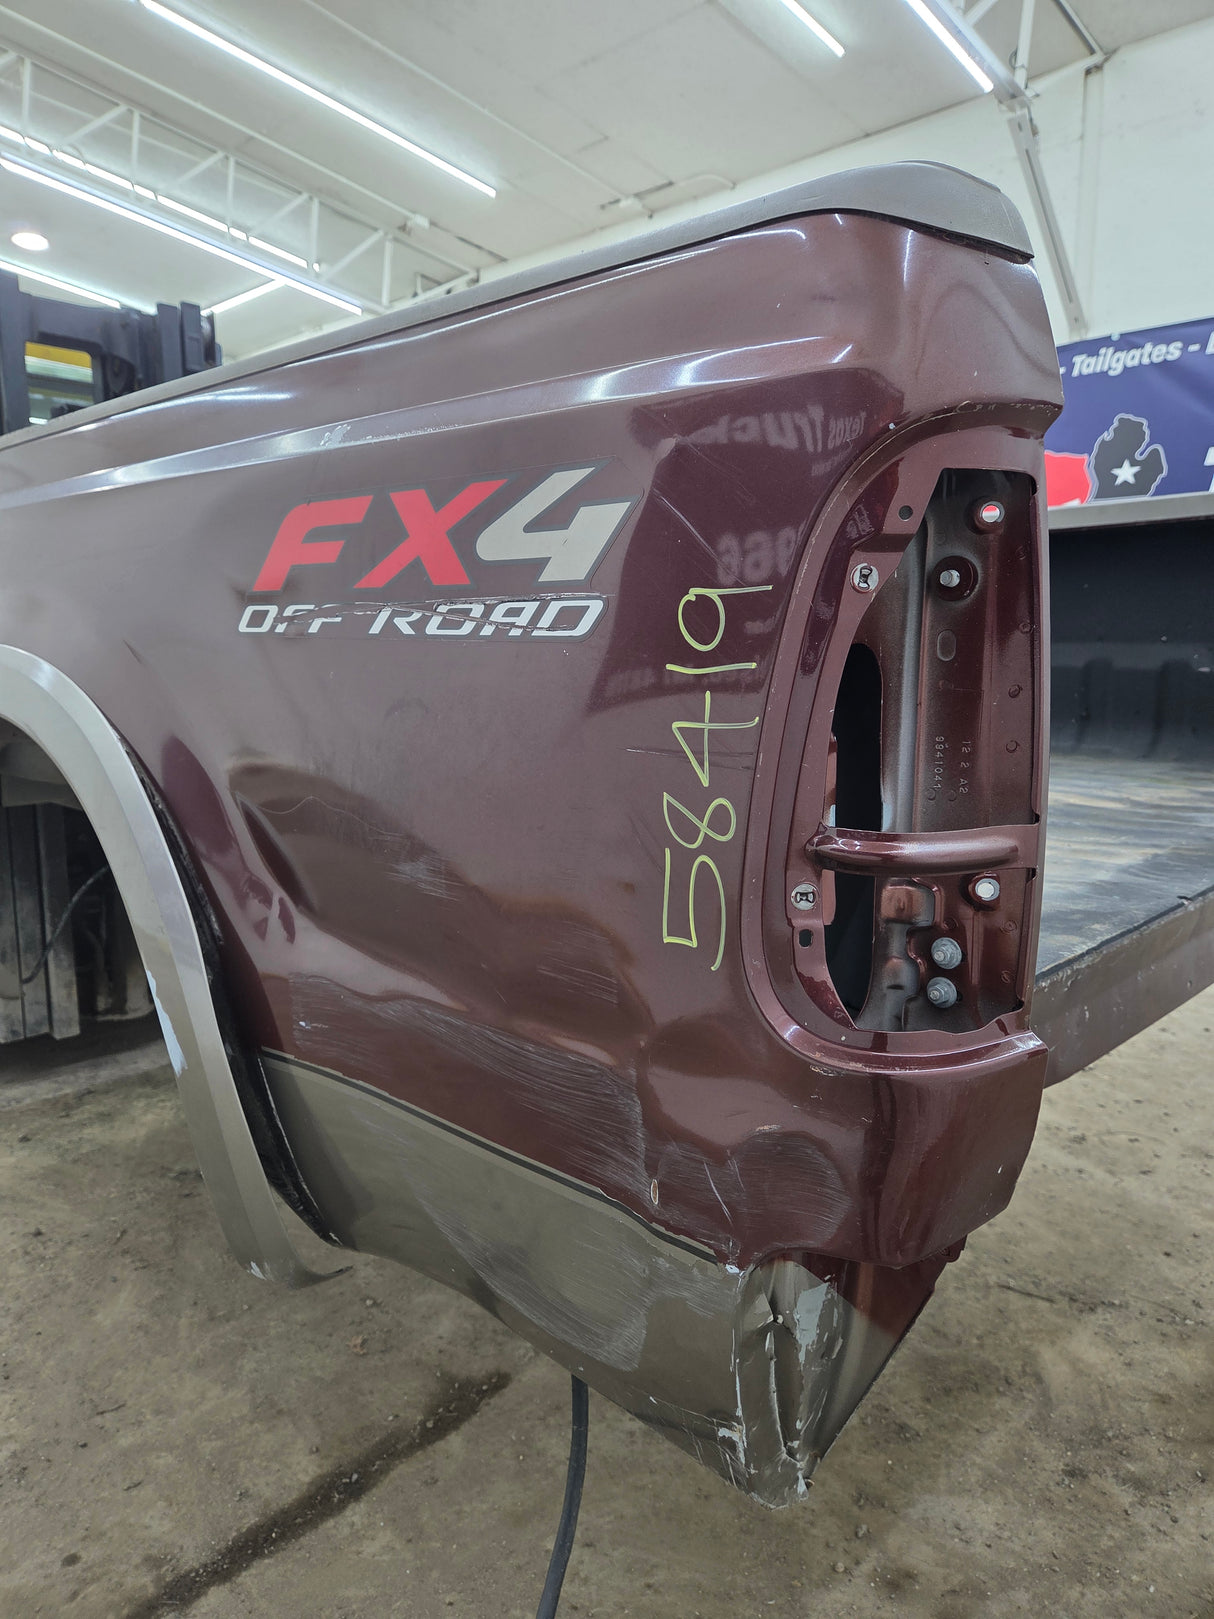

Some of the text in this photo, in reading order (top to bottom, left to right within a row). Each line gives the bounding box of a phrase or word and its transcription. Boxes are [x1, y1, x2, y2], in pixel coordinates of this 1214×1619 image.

[1071, 341, 1184, 378] Tailgates
[251, 466, 632, 592] FX4
[367, 600, 605, 638] ROAD
[662, 584, 774, 972] 58419
